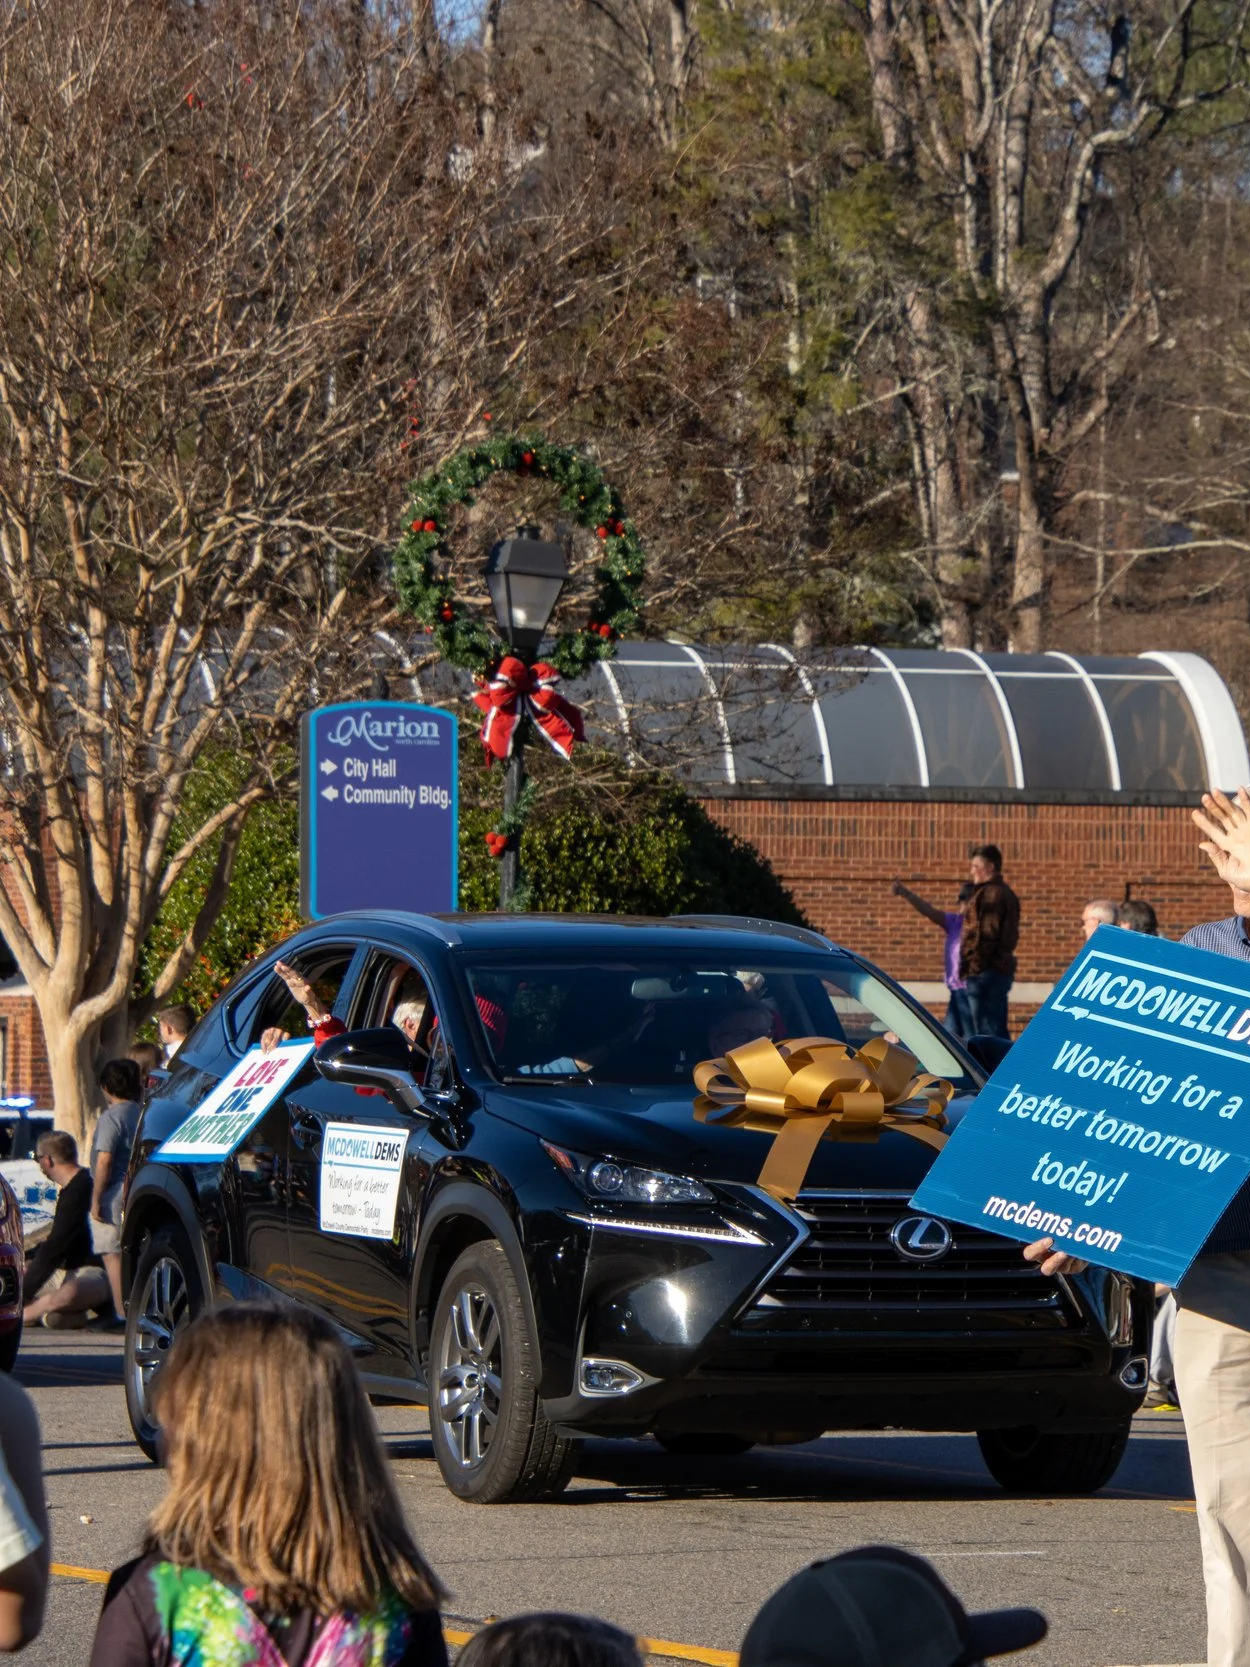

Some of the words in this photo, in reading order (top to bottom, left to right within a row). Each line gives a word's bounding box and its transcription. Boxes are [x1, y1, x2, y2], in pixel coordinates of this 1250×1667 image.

[327, 711, 440, 751] Marion
[343, 757, 369, 781] City
[372, 758, 397, 777] Hall
[343, 784, 416, 809] Community
[419, 785, 452, 810] Bldg.
[233, 1058, 289, 1088] LOVE
[1051, 1040, 1172, 1105] Working
[1172, 1073, 1221, 1112] for
[1219, 1093, 1243, 1120] a
[215, 1087, 264, 1114] ONE
[167, 1112, 256, 1146] ANOTHER
[998, 1083, 1089, 1132] better
[1085, 1109, 1231, 1174] tomorrow
[327, 1136, 401, 1162] MCDOWELLDEMS
[1031, 1151, 1129, 1208] today!
[982, 1195, 1123, 1253] mcdems.com
